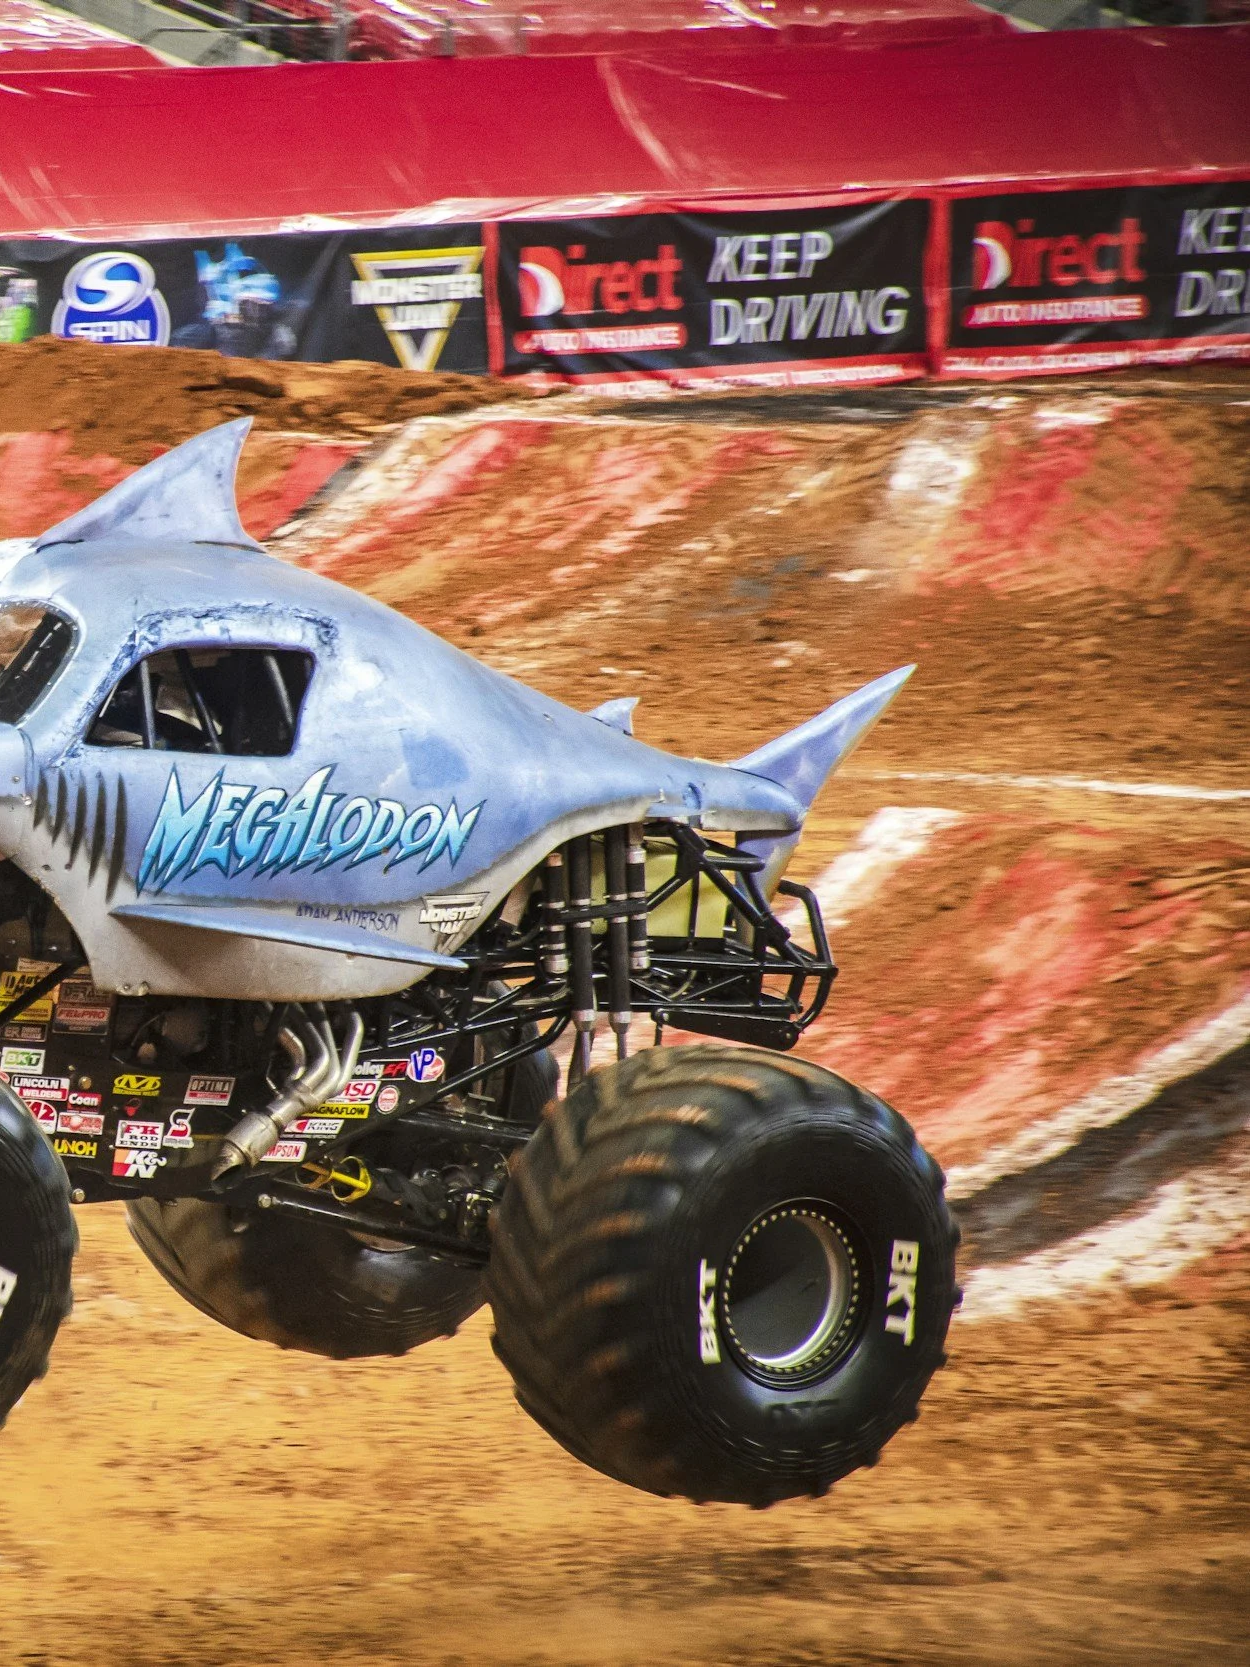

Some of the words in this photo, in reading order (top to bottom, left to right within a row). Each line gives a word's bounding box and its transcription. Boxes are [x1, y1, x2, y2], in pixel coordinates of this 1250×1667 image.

[707, 231, 834, 282] KEEP
[972, 218, 1147, 290] Direct
[518, 244, 684, 316] Direct
[709, 286, 911, 345] DRIVING
[69, 320, 150, 343] SPIN
[136, 762, 488, 898] MEGALODON
[296, 903, 330, 918] ADAM
[335, 907, 400, 931] ANDERSON
[419, 905, 483, 924] MONSTER
[6, 1052, 41, 1066] BKT
[411, 1048, 436, 1081] VP
[352, 1061, 385, 1079] olley
[14, 1078, 60, 1089] LINCOLN
[191, 1080, 230, 1092] OPTIMA
[22, 1089, 63, 1099] WELDERS
[68, 1092, 99, 1106] Coan
[310, 1106, 367, 1116] AGNAFLOW
[124, 1124, 160, 1135] FK
[307, 1121, 340, 1132] KING
[54, 1138, 98, 1156] UNOH
[267, 1145, 301, 1158] MPSON
[124, 1149, 167, 1178] K&N
[885, 1240, 919, 1347] BKT
[699, 1258, 721, 1365] BKT
